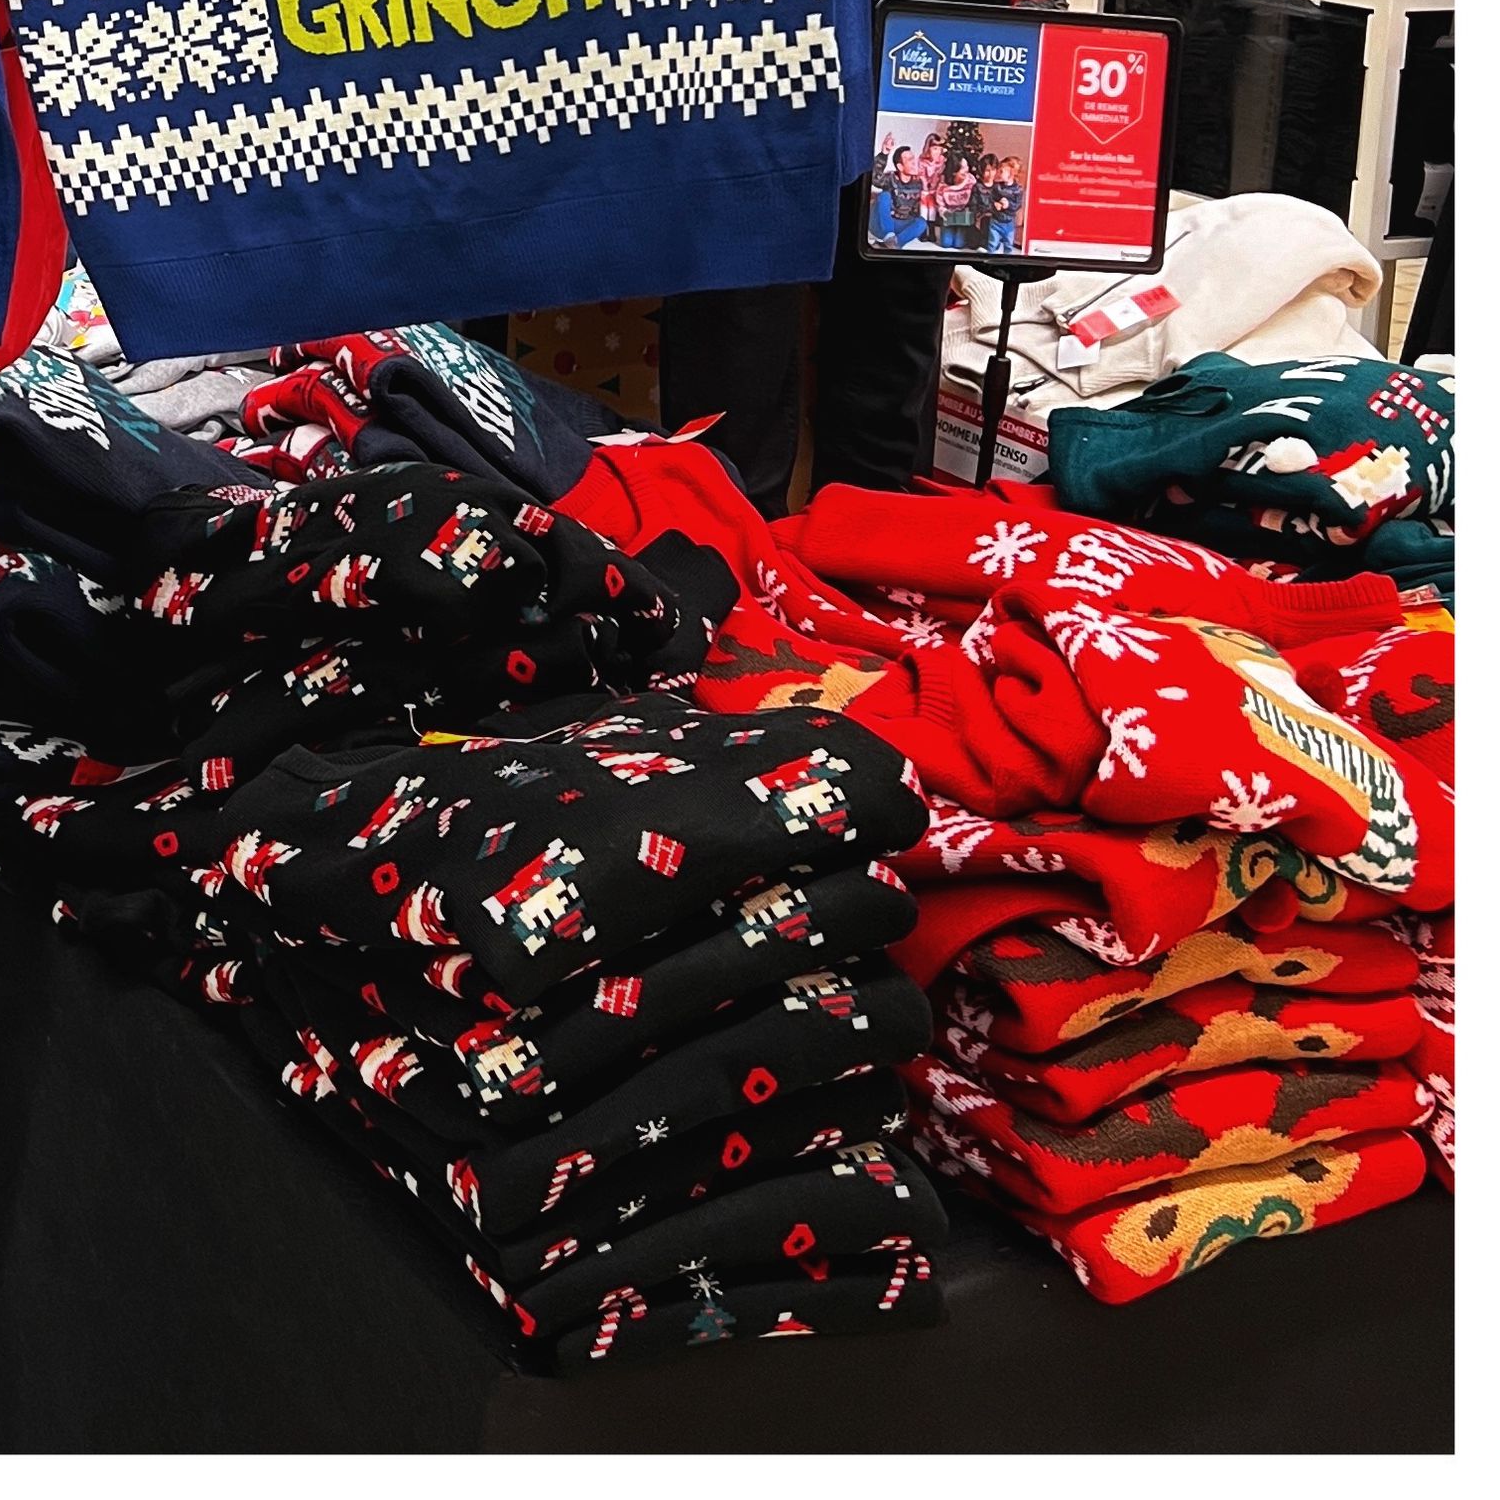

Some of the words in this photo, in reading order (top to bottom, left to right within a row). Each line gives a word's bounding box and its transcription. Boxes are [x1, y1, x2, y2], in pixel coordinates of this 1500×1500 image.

[950, 42, 973, 60] LA
[976, 44, 1029, 65] MODE
[948, 62, 971, 80] EN
[974, 61, 1026, 84] FÊTES
[1077, 53, 1145, 98] 30%
[964, 406, 977, 419] AU
[1036, 433, 1049, 448] 20
